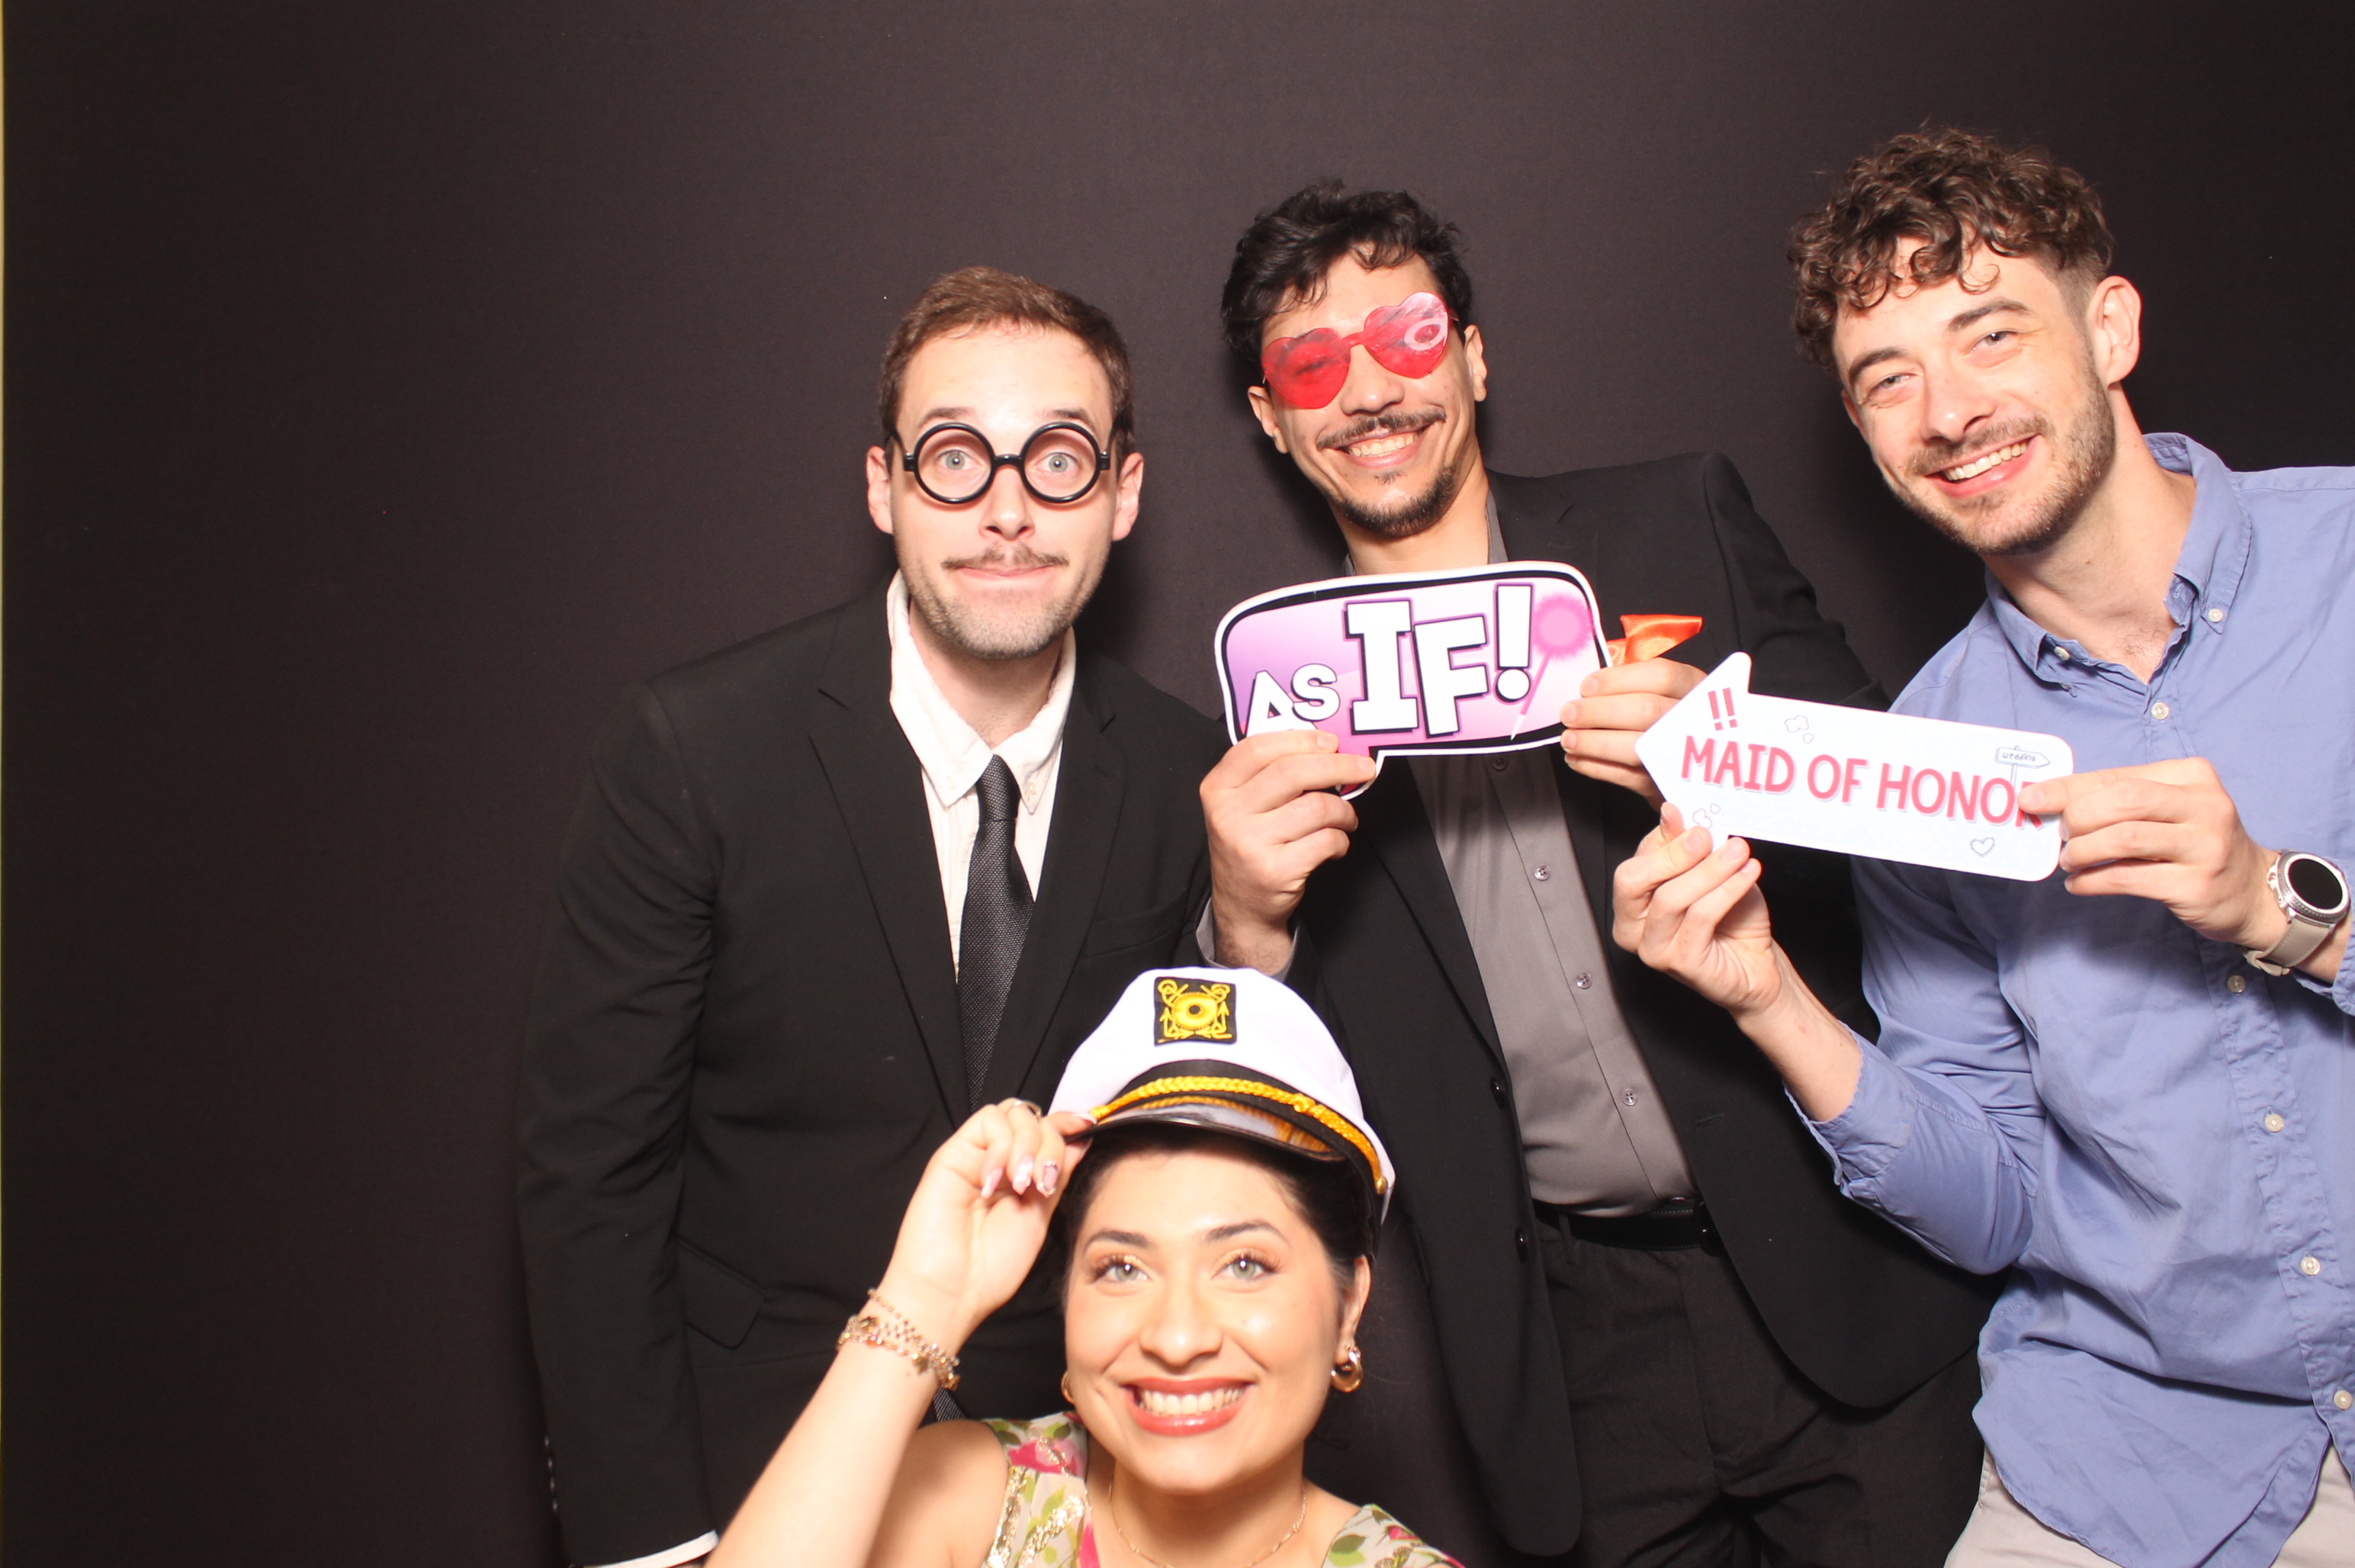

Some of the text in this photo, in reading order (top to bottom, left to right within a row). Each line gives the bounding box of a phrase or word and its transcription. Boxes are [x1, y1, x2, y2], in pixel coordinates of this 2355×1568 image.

[1245, 583, 1534, 738] AS IF!
[1680, 735, 1795, 793] MAID
[1807, 753, 1868, 804] OF
